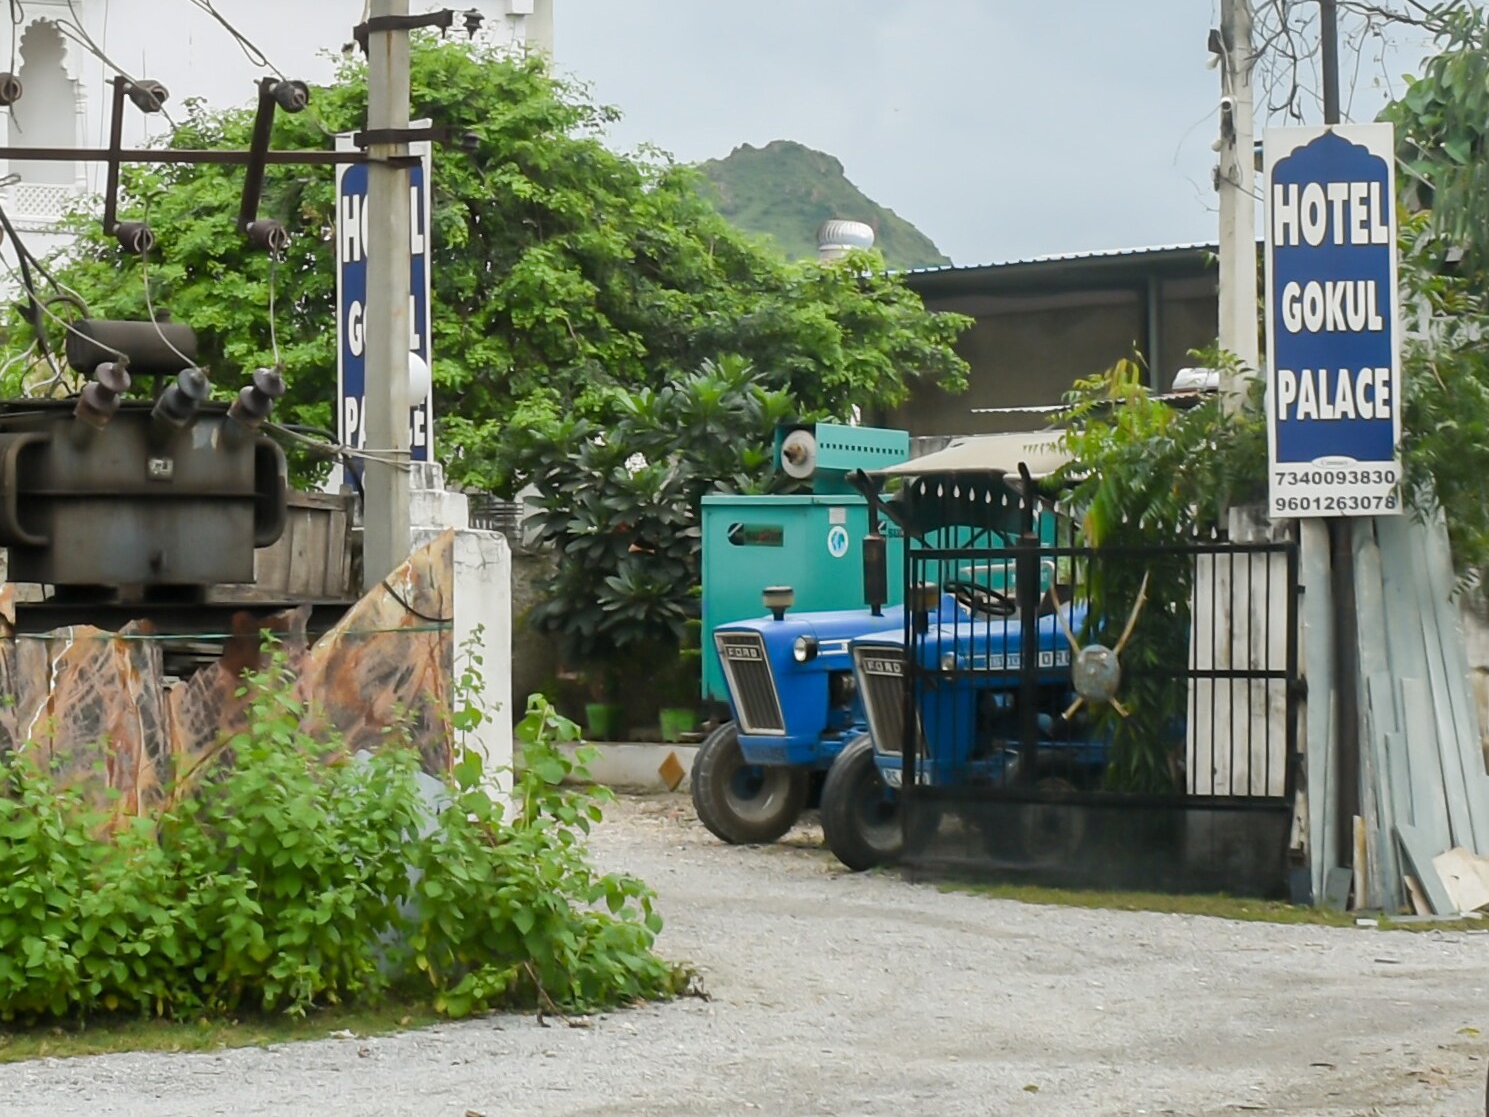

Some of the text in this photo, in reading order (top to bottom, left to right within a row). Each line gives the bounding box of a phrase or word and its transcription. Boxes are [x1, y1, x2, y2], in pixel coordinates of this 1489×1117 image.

[1274, 182, 1389, 247] HOTEL
[1282, 280, 1383, 333] GOKUL
[1278, 367, 1391, 421] PALACE
[1275, 470, 1395, 485] 7340093830
[1275, 496, 1396, 511] 9601263078
[727, 647, 758, 658] FORD
[867, 660, 901, 673] FORD
